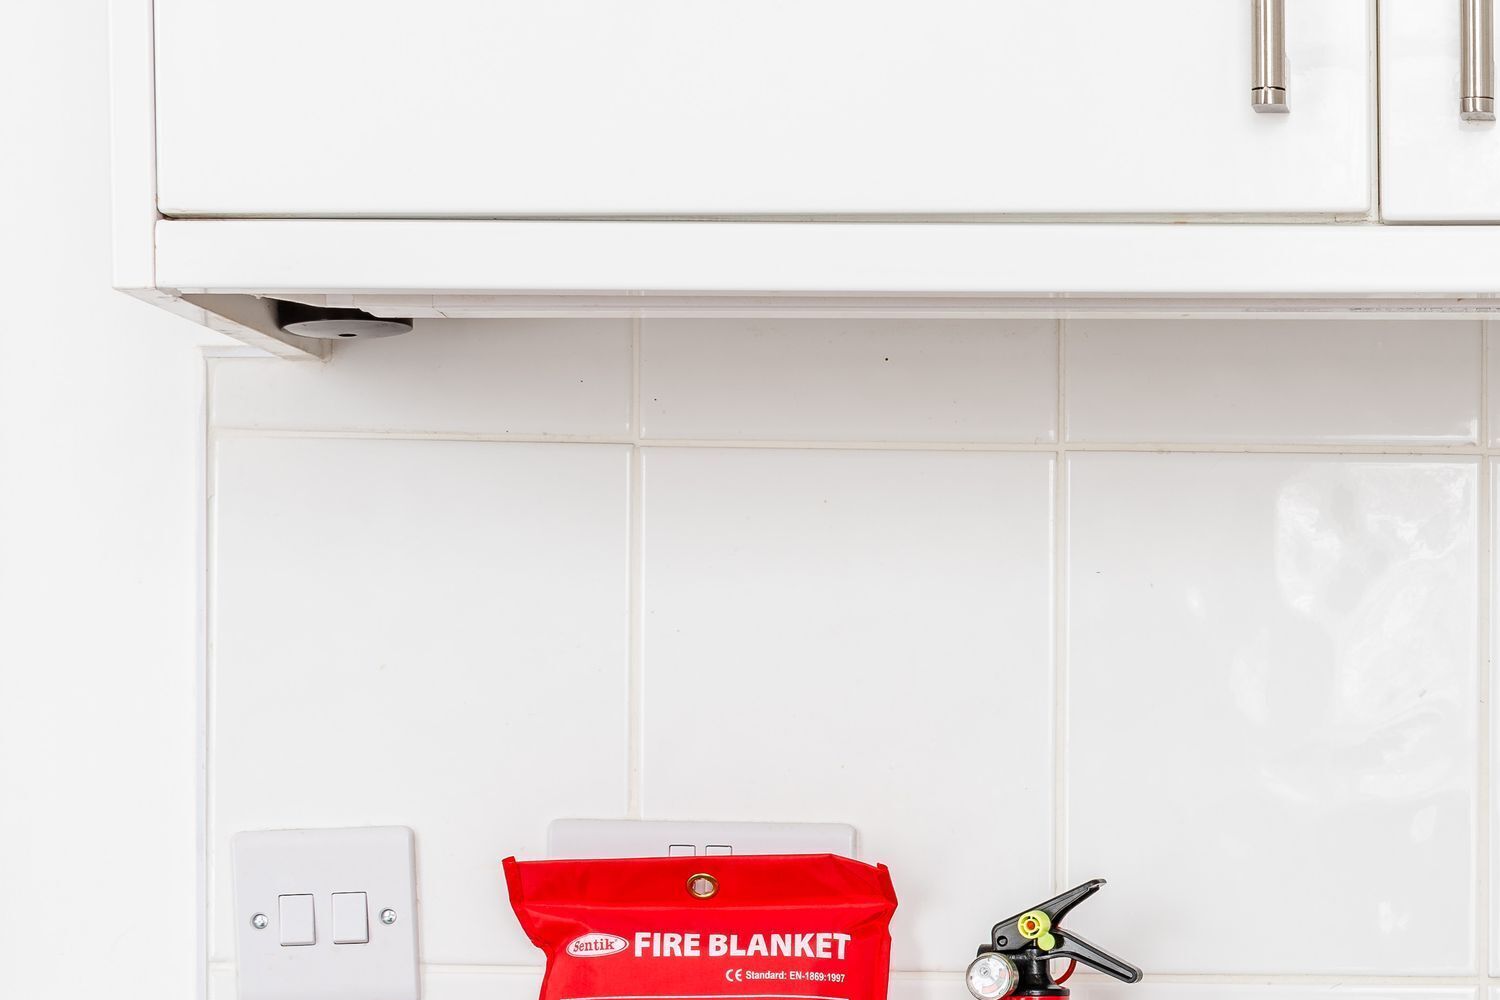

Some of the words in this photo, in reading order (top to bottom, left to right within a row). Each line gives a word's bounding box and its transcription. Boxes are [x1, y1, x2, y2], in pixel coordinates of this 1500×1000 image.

[574, 939, 615, 952] Sentik
[634, 931, 701, 958] FIRE
[708, 932, 852, 960] BLANKET
[746, 971, 787, 980] Standard:
[790, 971, 846, 983] EN-1869:1997
